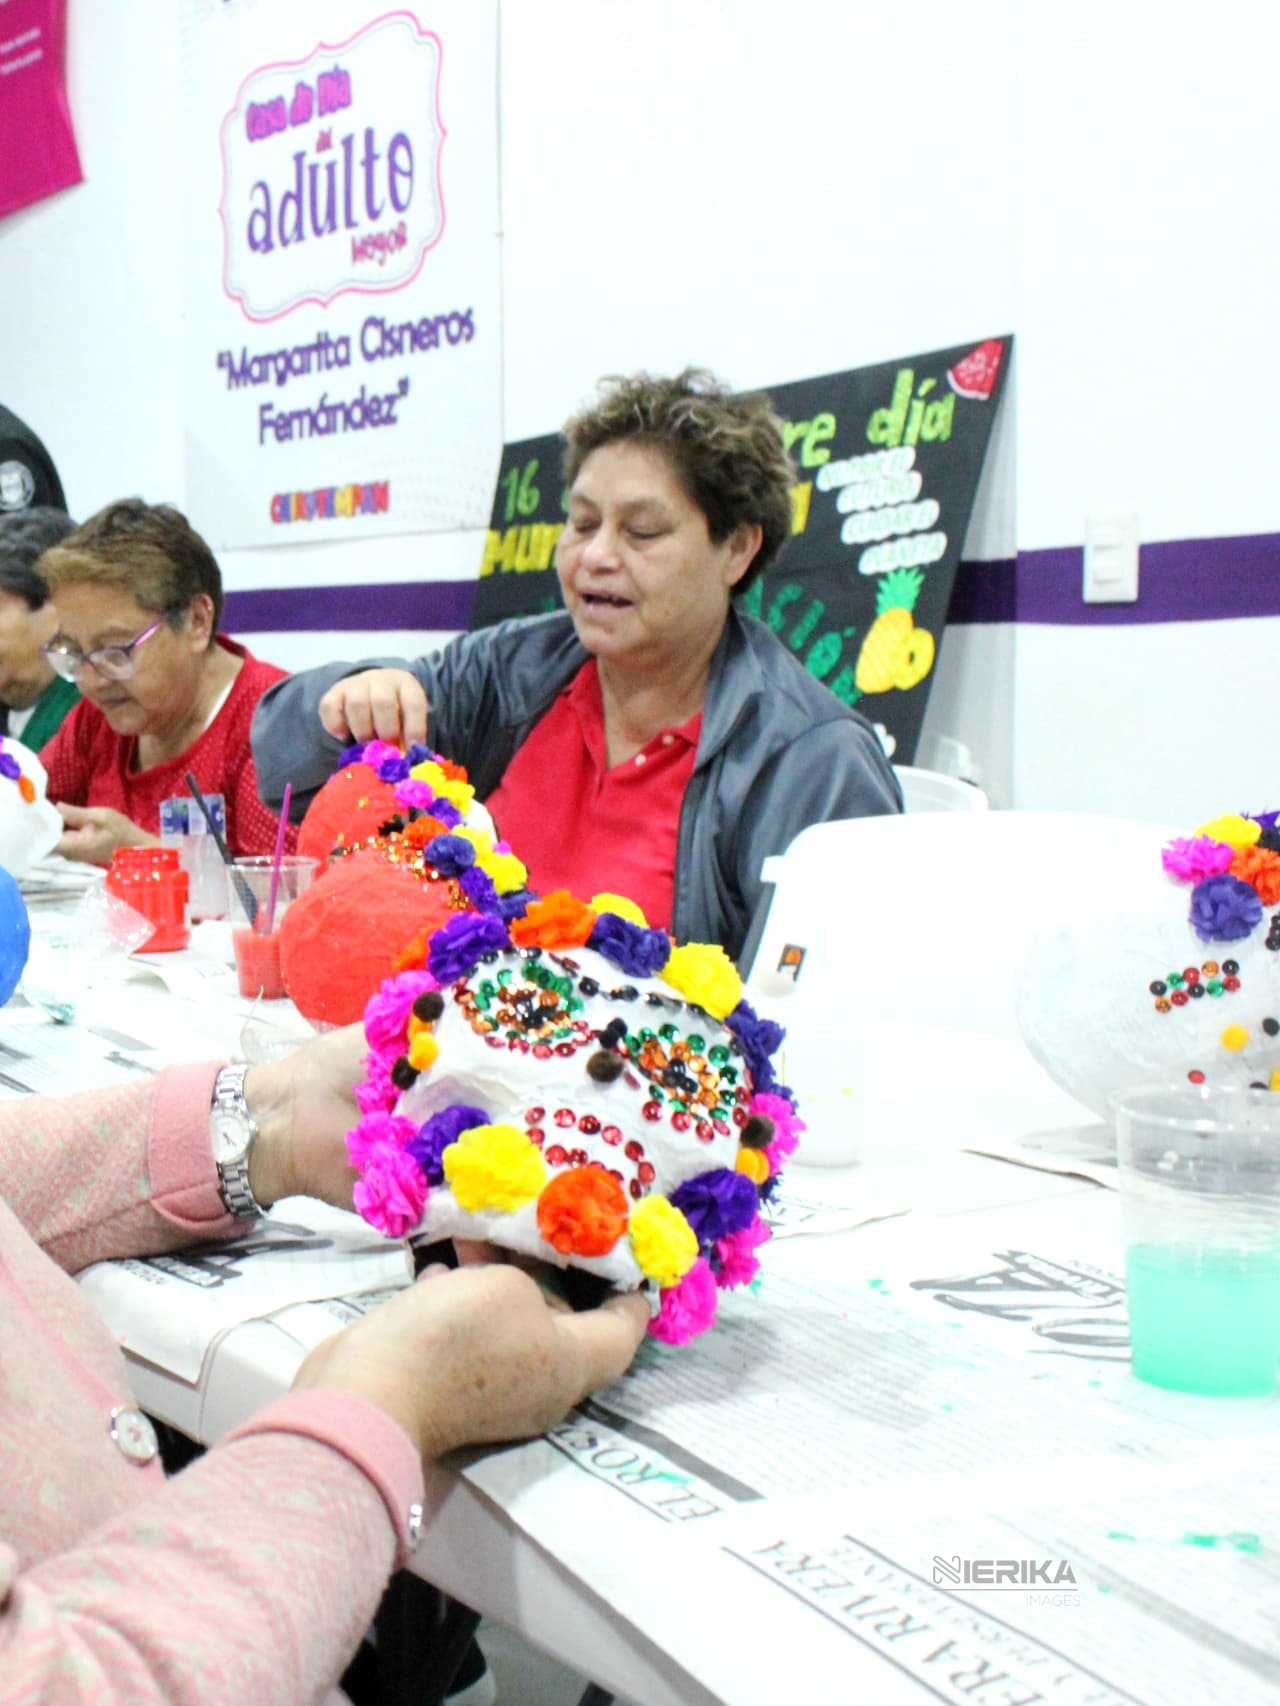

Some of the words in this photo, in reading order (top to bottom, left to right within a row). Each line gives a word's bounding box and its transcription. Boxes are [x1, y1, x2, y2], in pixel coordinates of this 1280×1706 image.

[247, 126, 414, 254] adulto
[867, 368, 956, 447] día
[501, 458, 540, 522] 16
